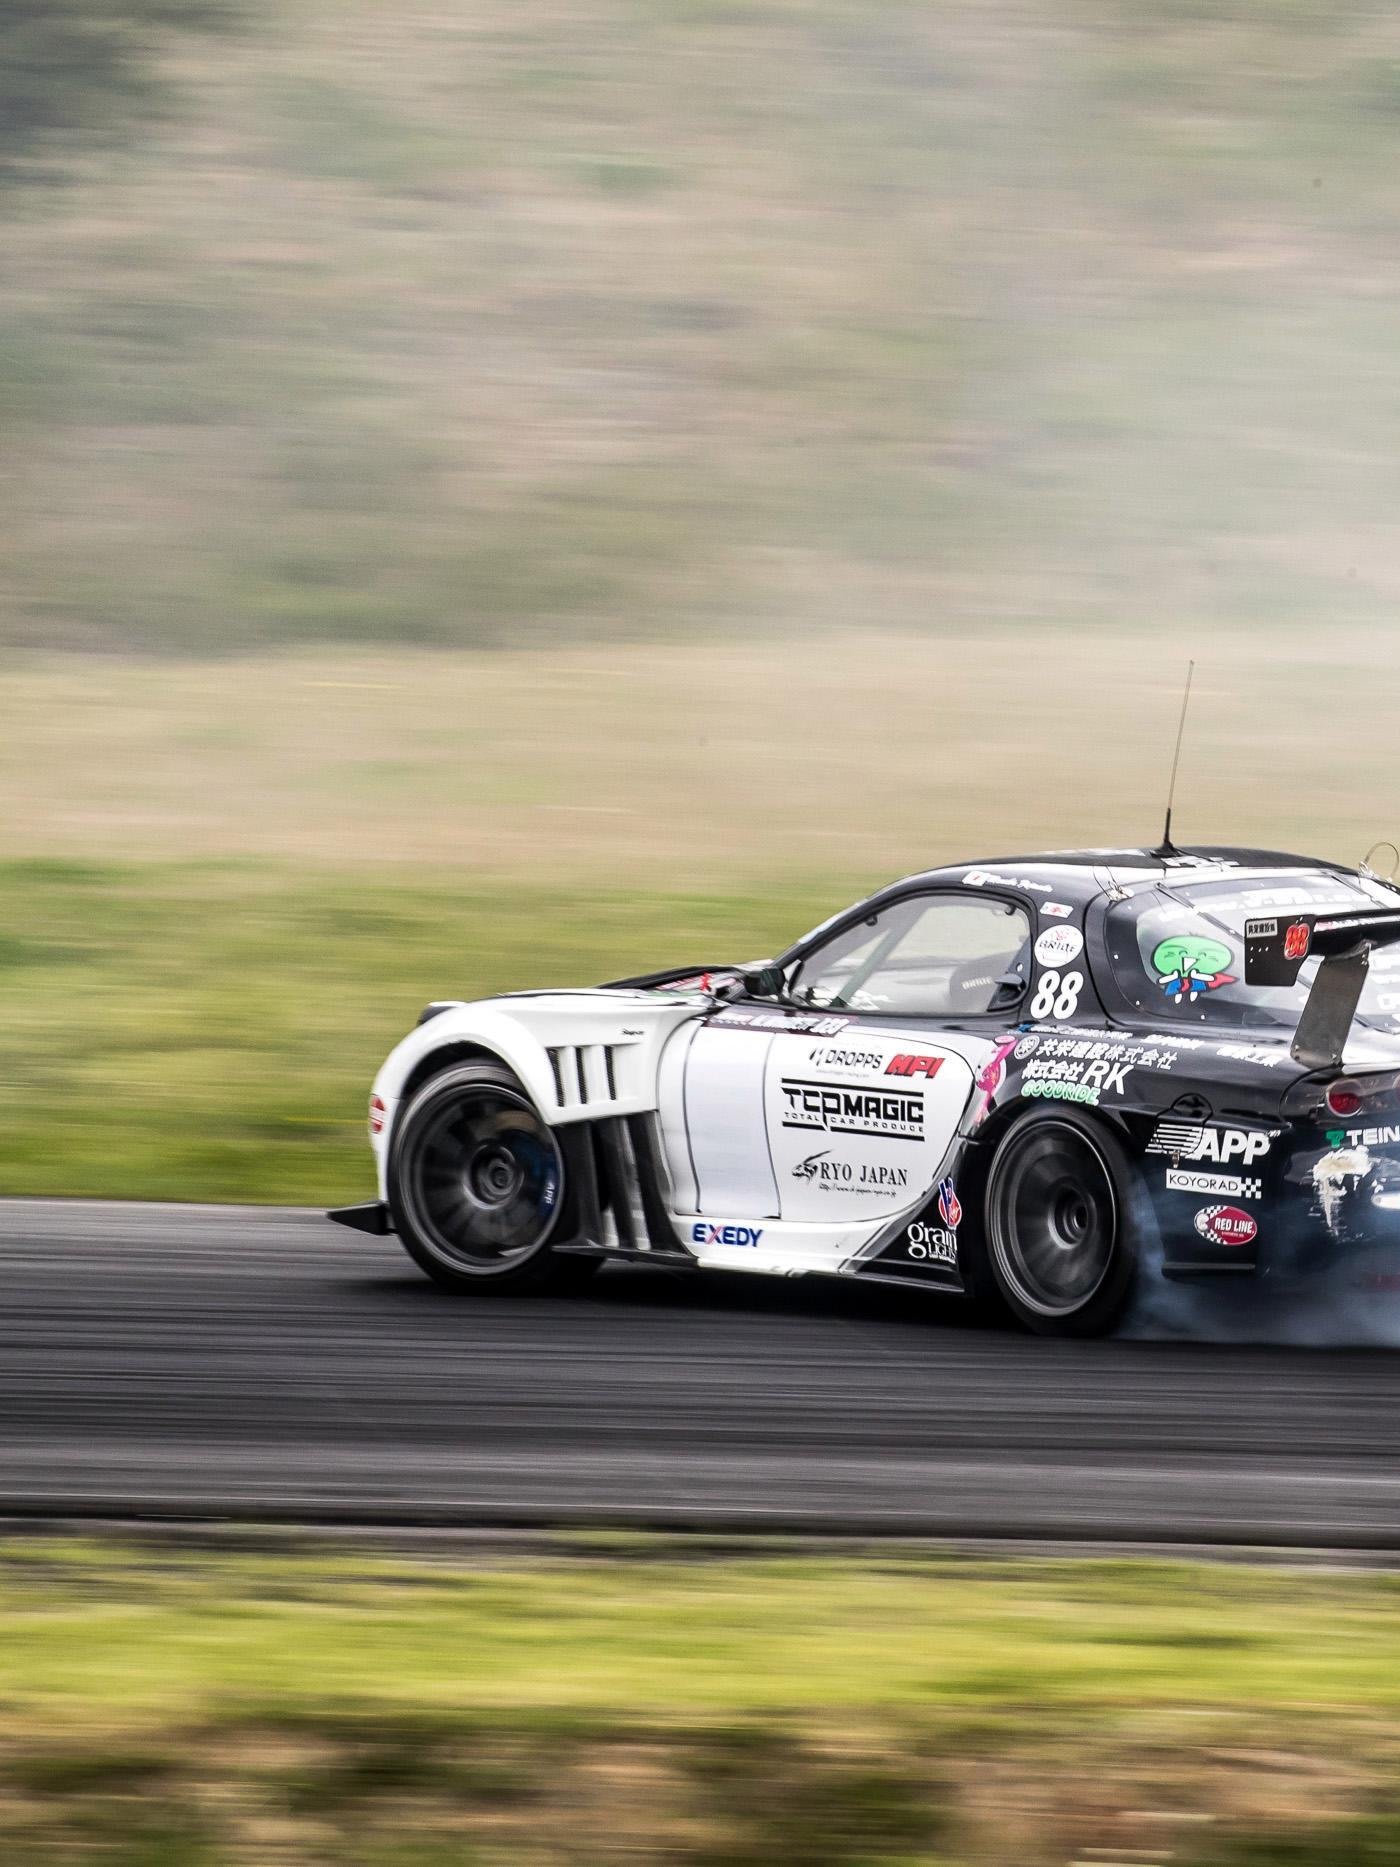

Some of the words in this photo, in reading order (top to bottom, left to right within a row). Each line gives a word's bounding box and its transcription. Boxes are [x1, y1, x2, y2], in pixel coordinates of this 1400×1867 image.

[1284, 923, 1310, 960] 88
[1030, 970, 1084, 1020] 88
[825, 1049, 883, 1069] DROPPS
[1021, 1080, 1100, 1106] GOODRIDE
[784, 1112, 819, 1122] TOTAL
[831, 1116, 855, 1125] CAR
[864, 1120, 923, 1132] PRODUCE
[1190, 1128, 1271, 1165] APP
[1346, 1125, 1400, 1146] TEIN
[820, 1161, 851, 1181] RYO
[860, 1165, 908, 1186] JAPAN
[1169, 1174, 1238, 1192] KOYORAD
[693, 1223, 763, 1247] EXEDY
[1215, 1217, 1232, 1231] RED
